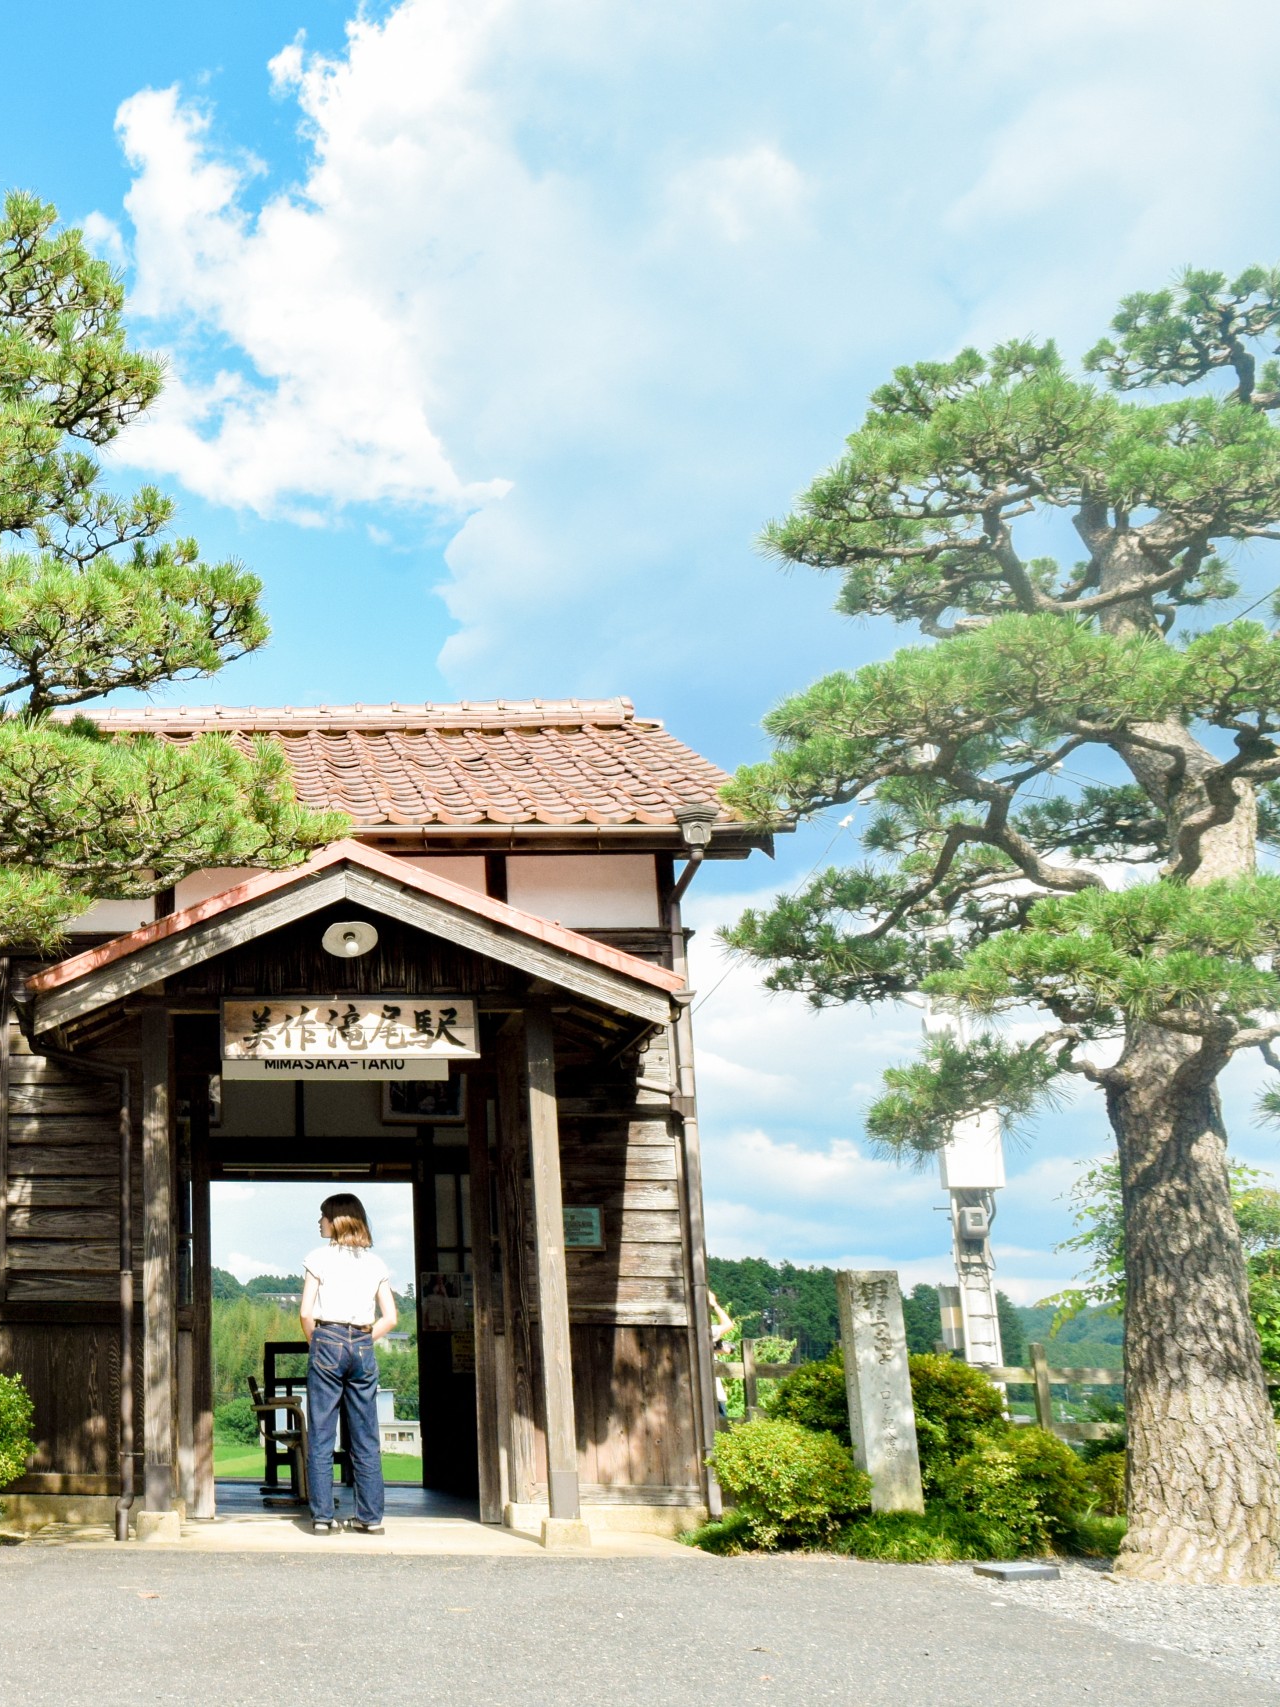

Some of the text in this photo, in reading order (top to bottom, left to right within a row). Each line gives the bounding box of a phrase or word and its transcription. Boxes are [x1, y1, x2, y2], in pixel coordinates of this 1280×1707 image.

[243, 1003, 466, 1051] 美作滝尾駅
